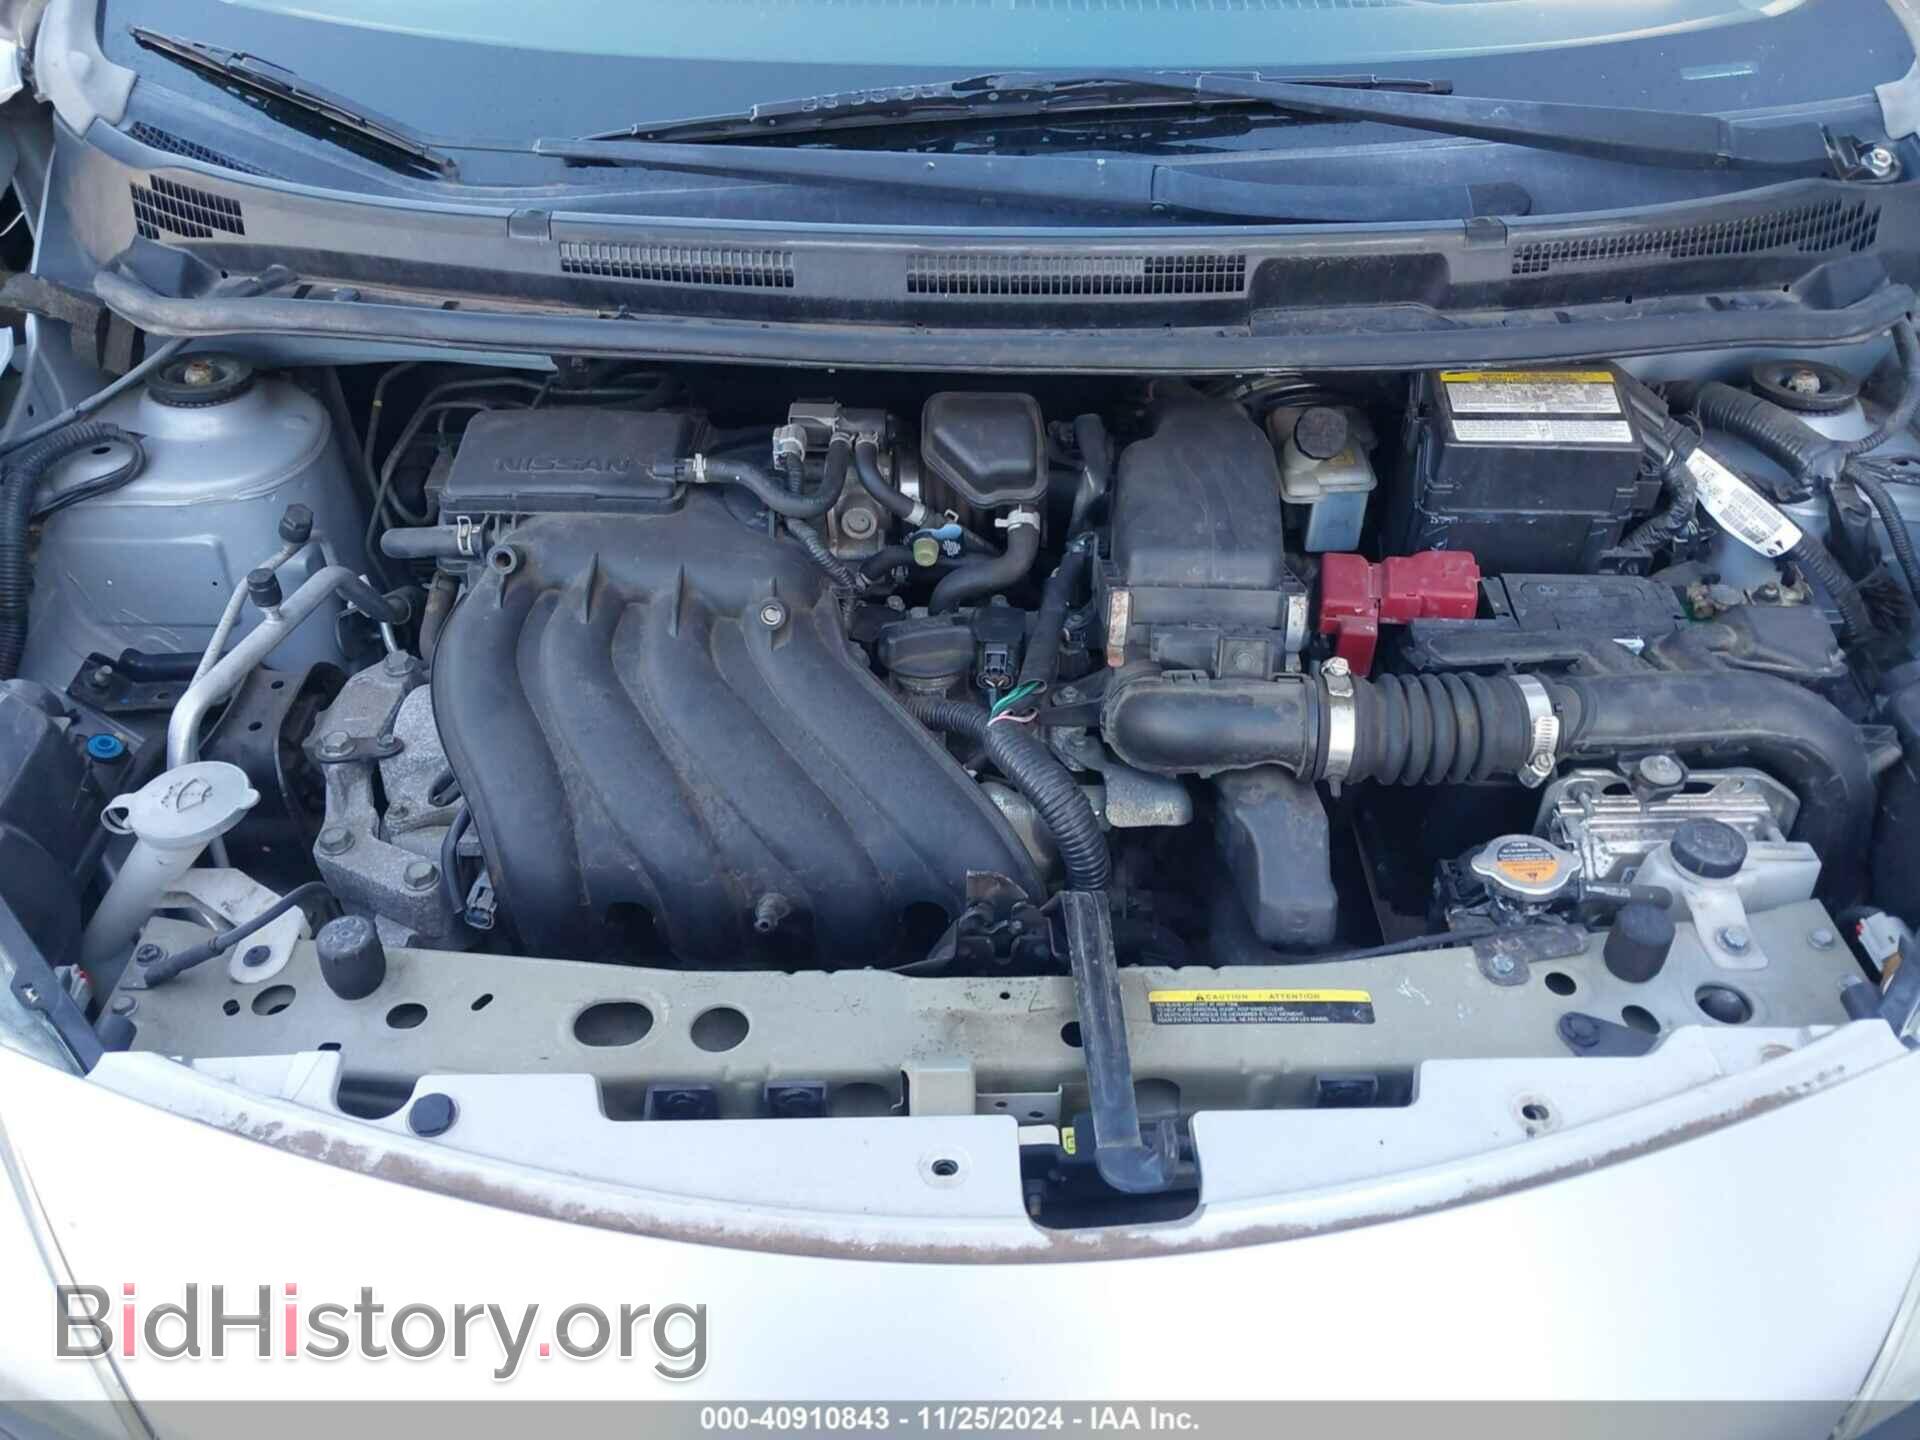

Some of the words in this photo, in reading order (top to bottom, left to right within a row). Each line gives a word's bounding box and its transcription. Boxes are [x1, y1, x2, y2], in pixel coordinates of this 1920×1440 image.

[494, 455, 631, 474] NISSAN
[1205, 992, 1249, 1000] CAUTION
[1269, 992, 1321, 1000] ATTENTION
